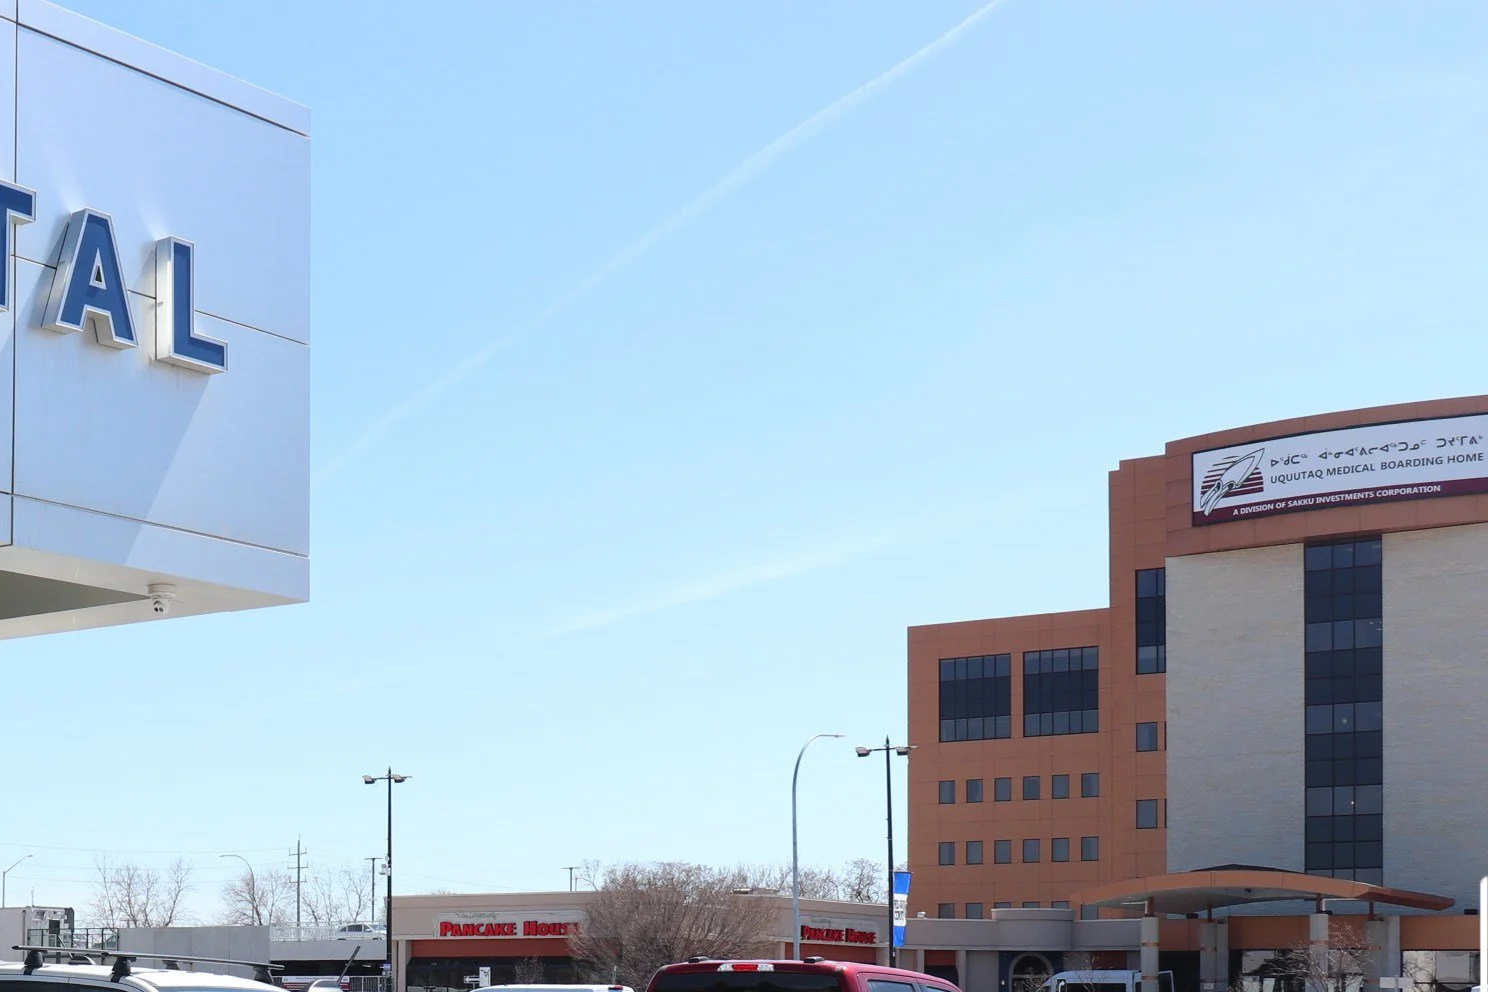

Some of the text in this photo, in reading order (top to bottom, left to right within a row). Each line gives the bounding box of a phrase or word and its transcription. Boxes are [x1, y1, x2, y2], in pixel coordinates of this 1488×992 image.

[1270, 452, 1484, 484] UQUUTAQ MEDICAL BOARDING HOME
[1232, 485, 1441, 516] A DIVISION OF SAKKU INVESTMENTS CORPORATION
[440, 921, 518, 936] PANCAKE
